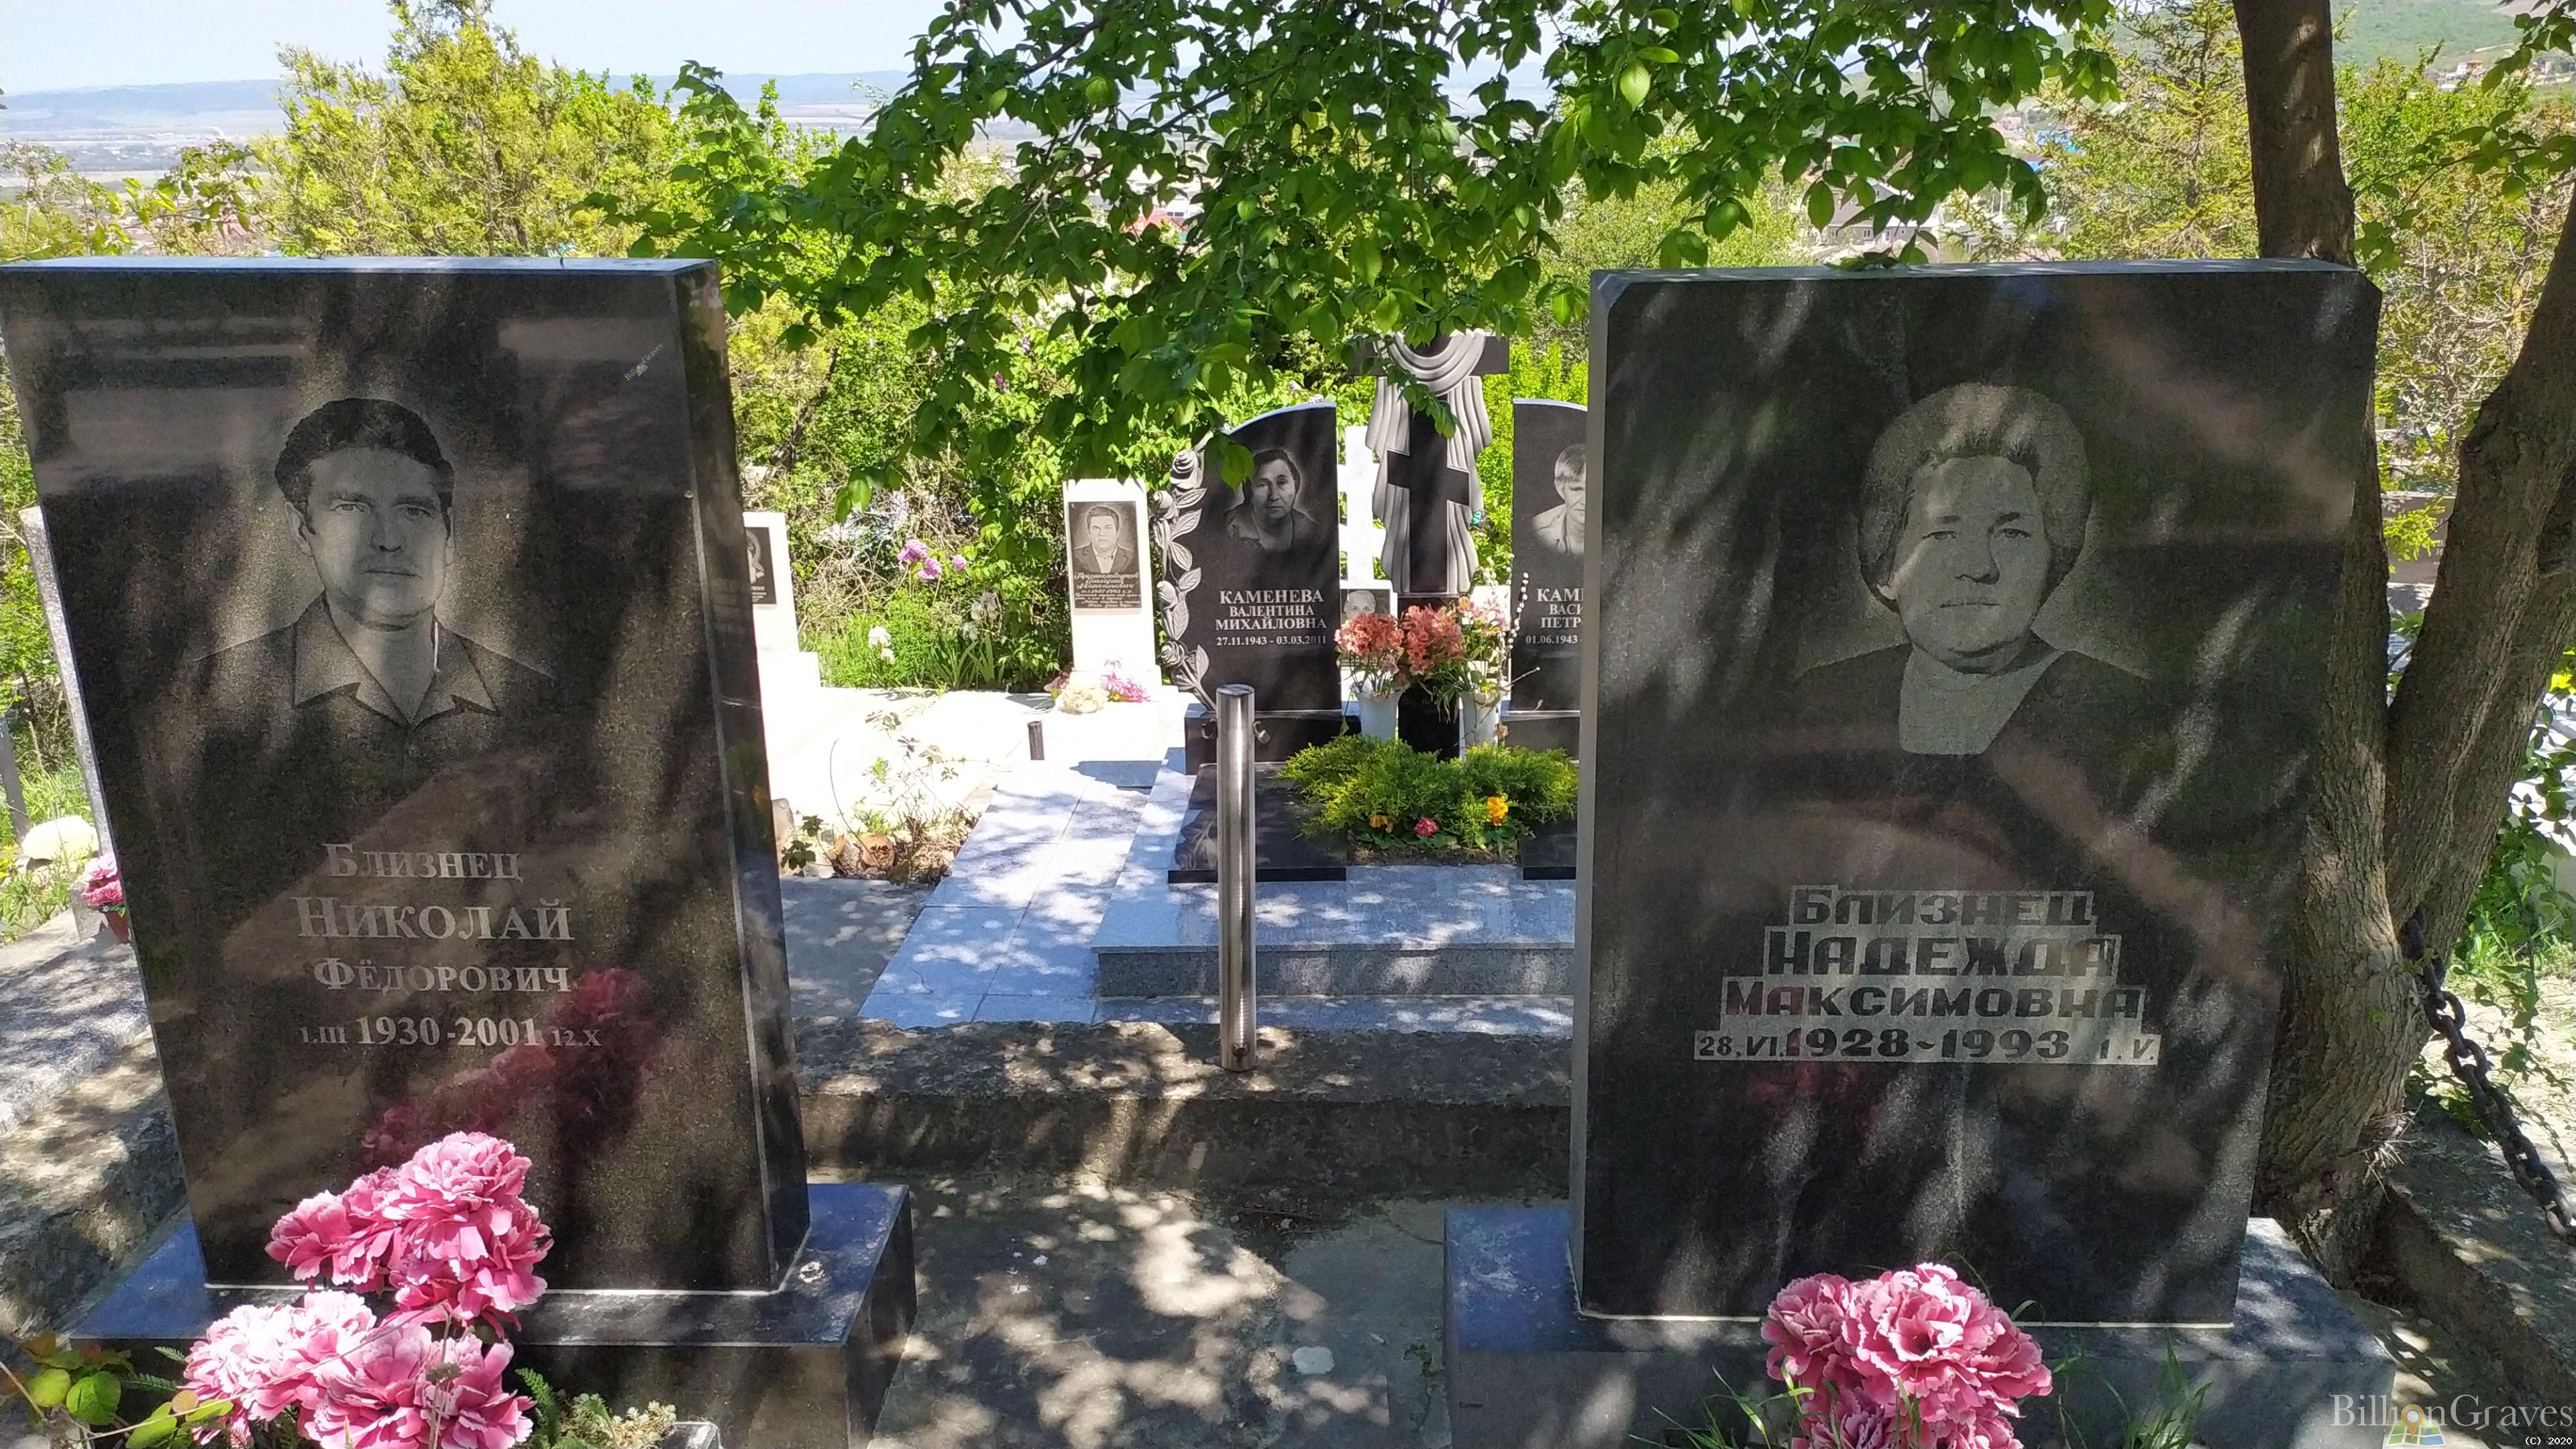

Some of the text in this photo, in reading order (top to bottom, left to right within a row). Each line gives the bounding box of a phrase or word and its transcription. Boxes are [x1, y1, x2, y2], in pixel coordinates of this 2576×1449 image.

[1219, 589, 1325, 604] КАМЕНЕВА
[1215, 616, 1327, 631] МИХАЙЛОВНА
[1229, 605, 1315, 617] ВАЛЕНТИНА
[1541, 617, 1582, 629] ПЕТР
[1216, 637, 1267, 646] 27.11.1943
[1276, 635, 1327, 645] 03.03.2011
[1525, 635, 1578, 644] 01.06.1943
[322, 843, 523, 882] БЛИЗНЕЦ
[291, 896, 575, 941] НИКОЛАЙ
[1794, 890, 2094, 925] БЛИЗНЕЦ
[1770, 930, 2113, 976] НАДЕЖДА
[314, 957, 572, 996] ФЁДОРОВИЧ
[1724, 981, 2141, 1018] МАКСИМОВНА
